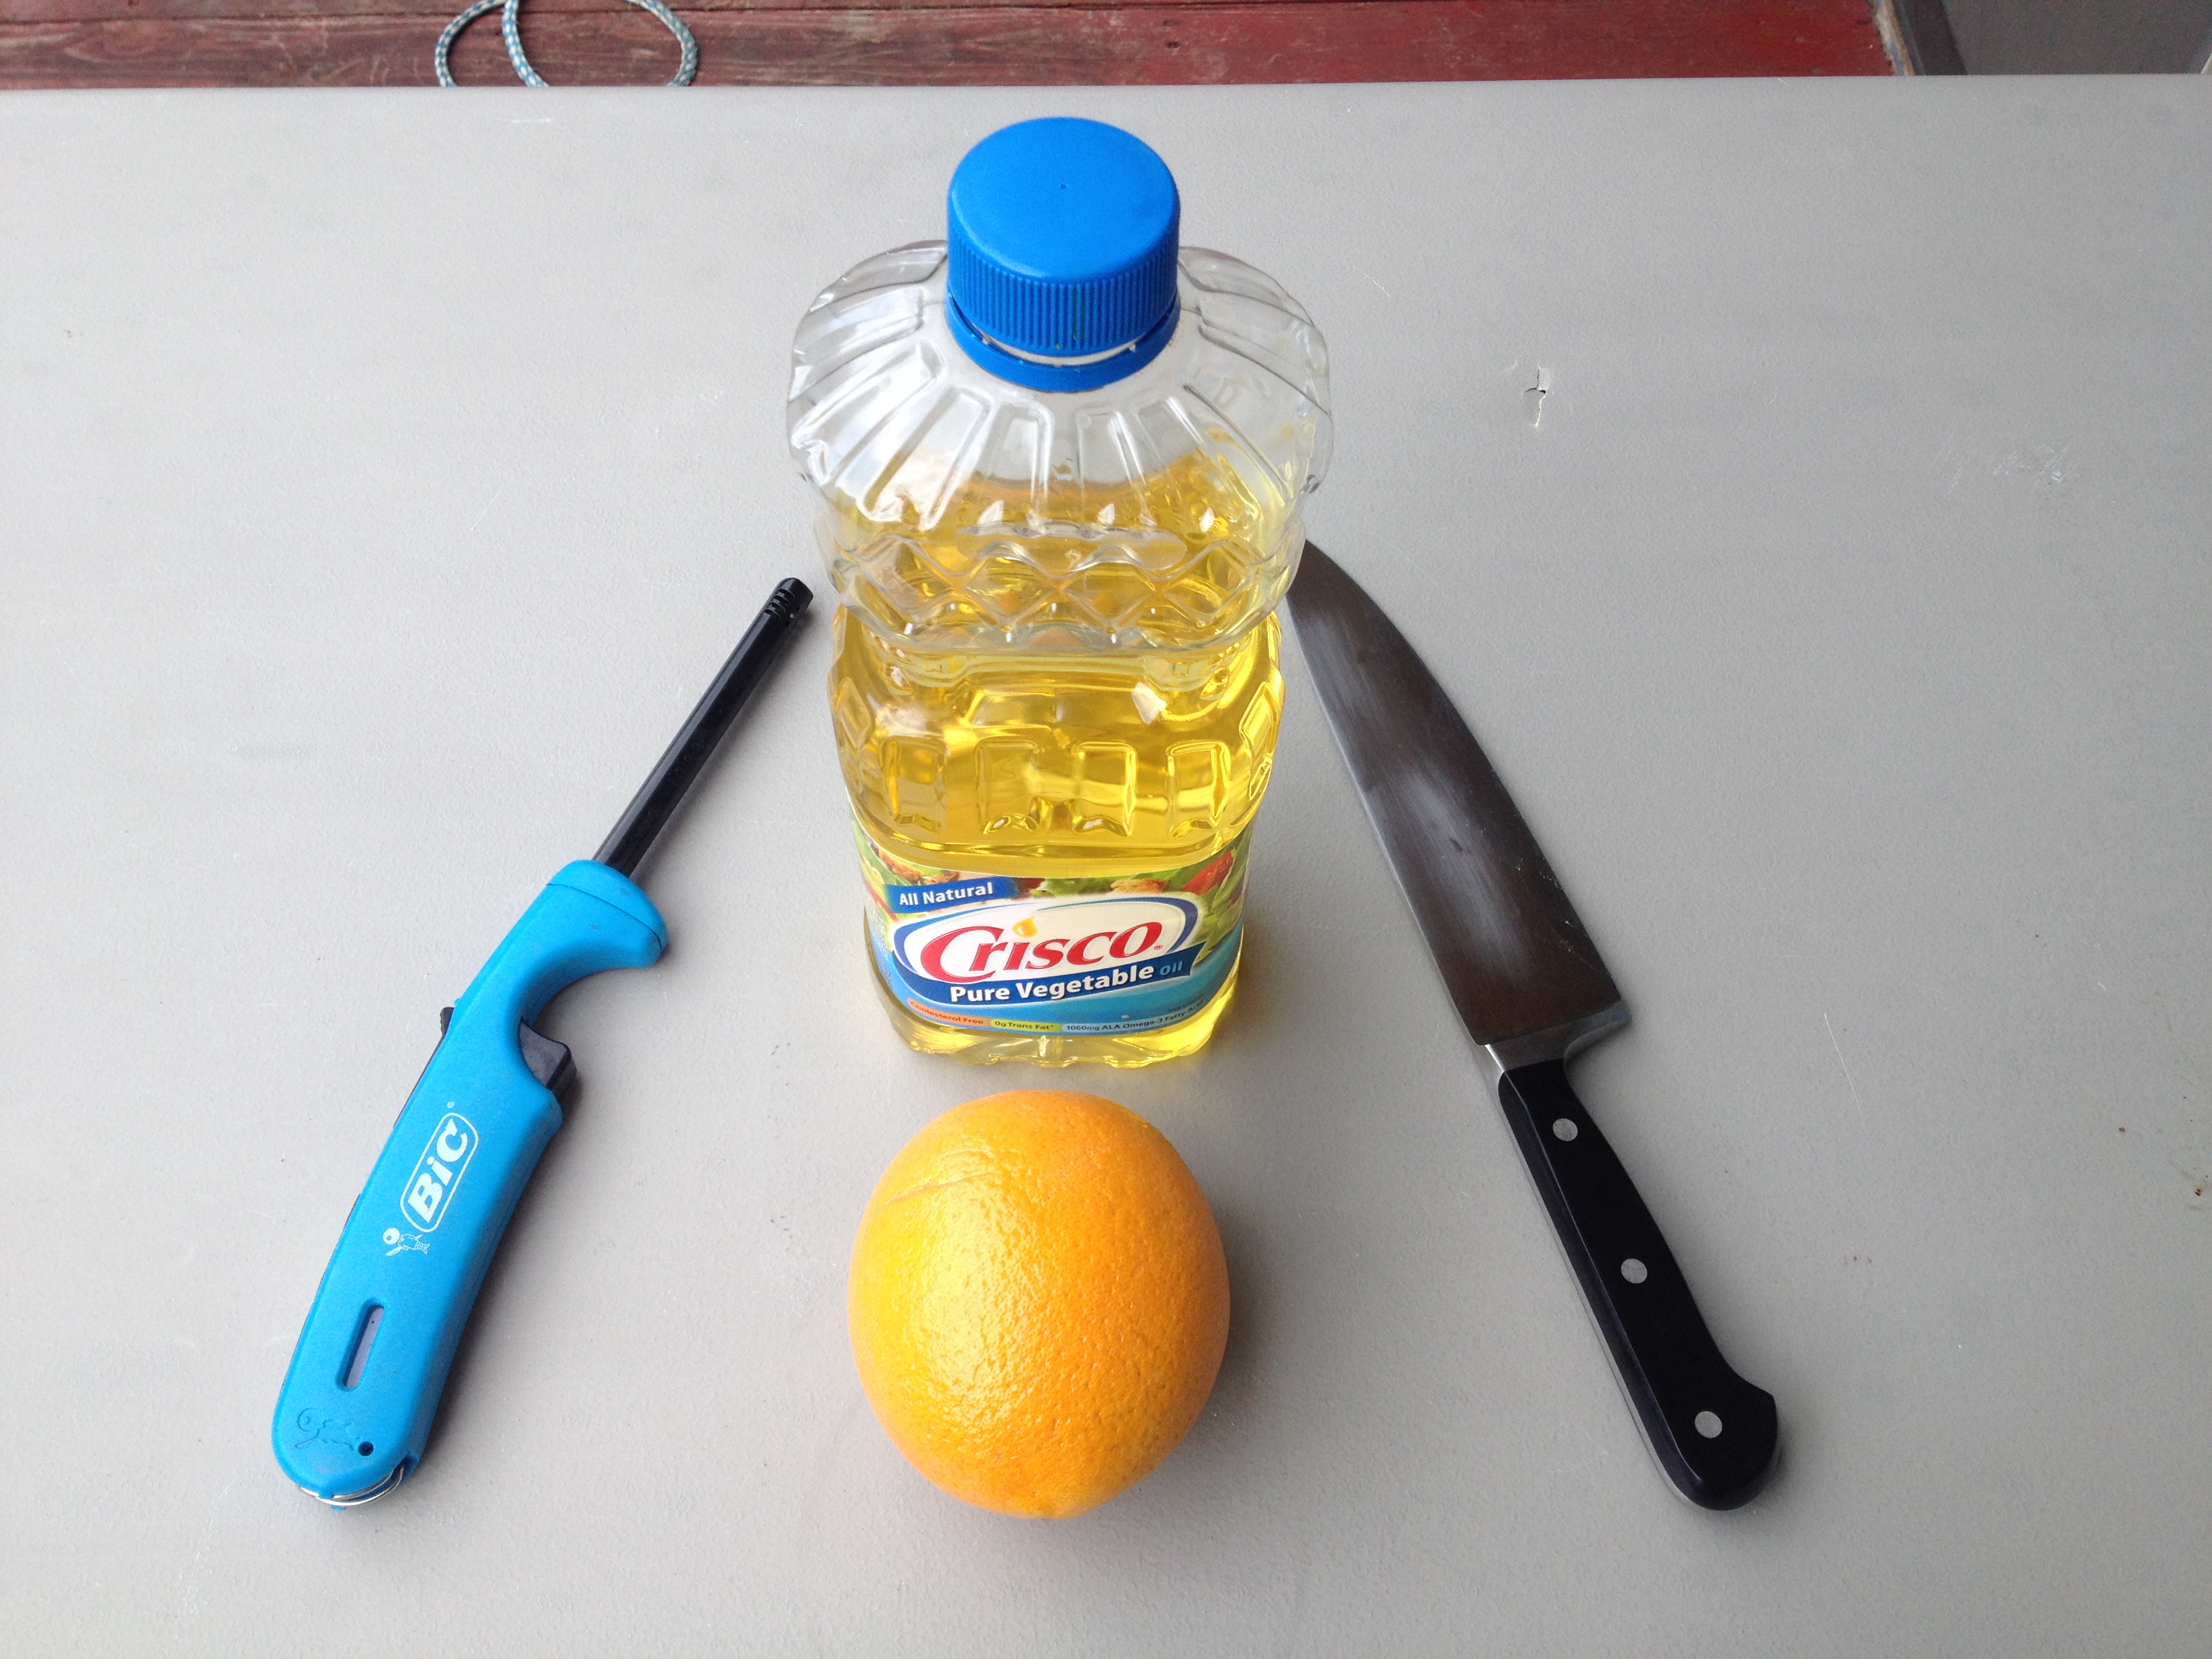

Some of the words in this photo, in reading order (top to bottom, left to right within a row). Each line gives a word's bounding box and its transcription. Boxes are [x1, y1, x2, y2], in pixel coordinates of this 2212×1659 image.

[899, 893, 919, 905] All
[922, 882, 994, 904] Natural
[920, 922, 1162, 983] Crisco
[950, 986, 1010, 1003] Pure
[1015, 964, 1154, 1000] Vegetable
[1160, 960, 1183, 976] oil
[910, 1000, 961, 1023] Cholesterol
[963, 1017, 983, 1025] Free
[1122, 1018, 1163, 1029] Omega-3
